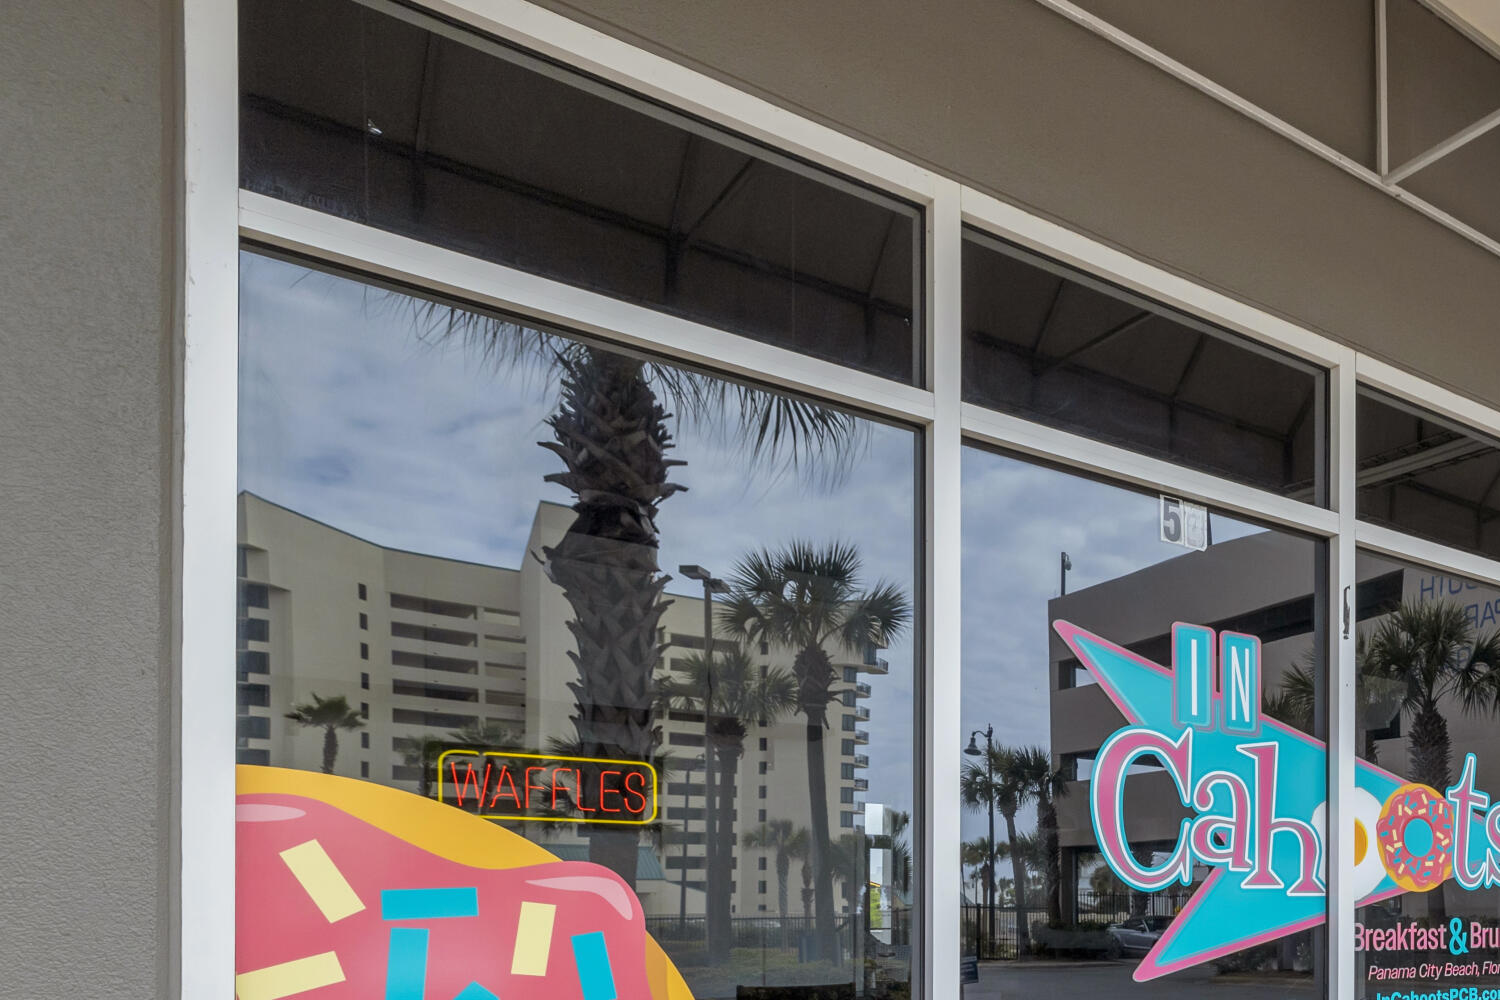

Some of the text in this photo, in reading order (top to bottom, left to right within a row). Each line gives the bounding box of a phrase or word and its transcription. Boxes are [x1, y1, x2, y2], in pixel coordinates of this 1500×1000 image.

[1184, 633, 1255, 727] IN
[450, 761, 647, 814] WAFFLES
[1354, 922, 1447, 951] Breakfast
[1449, 917, 1469, 956] &
[1368, 965, 1416, 981] Panama
[1418, 964, 1443, 981] City
[1444, 962, 1480, 977] Beach,
